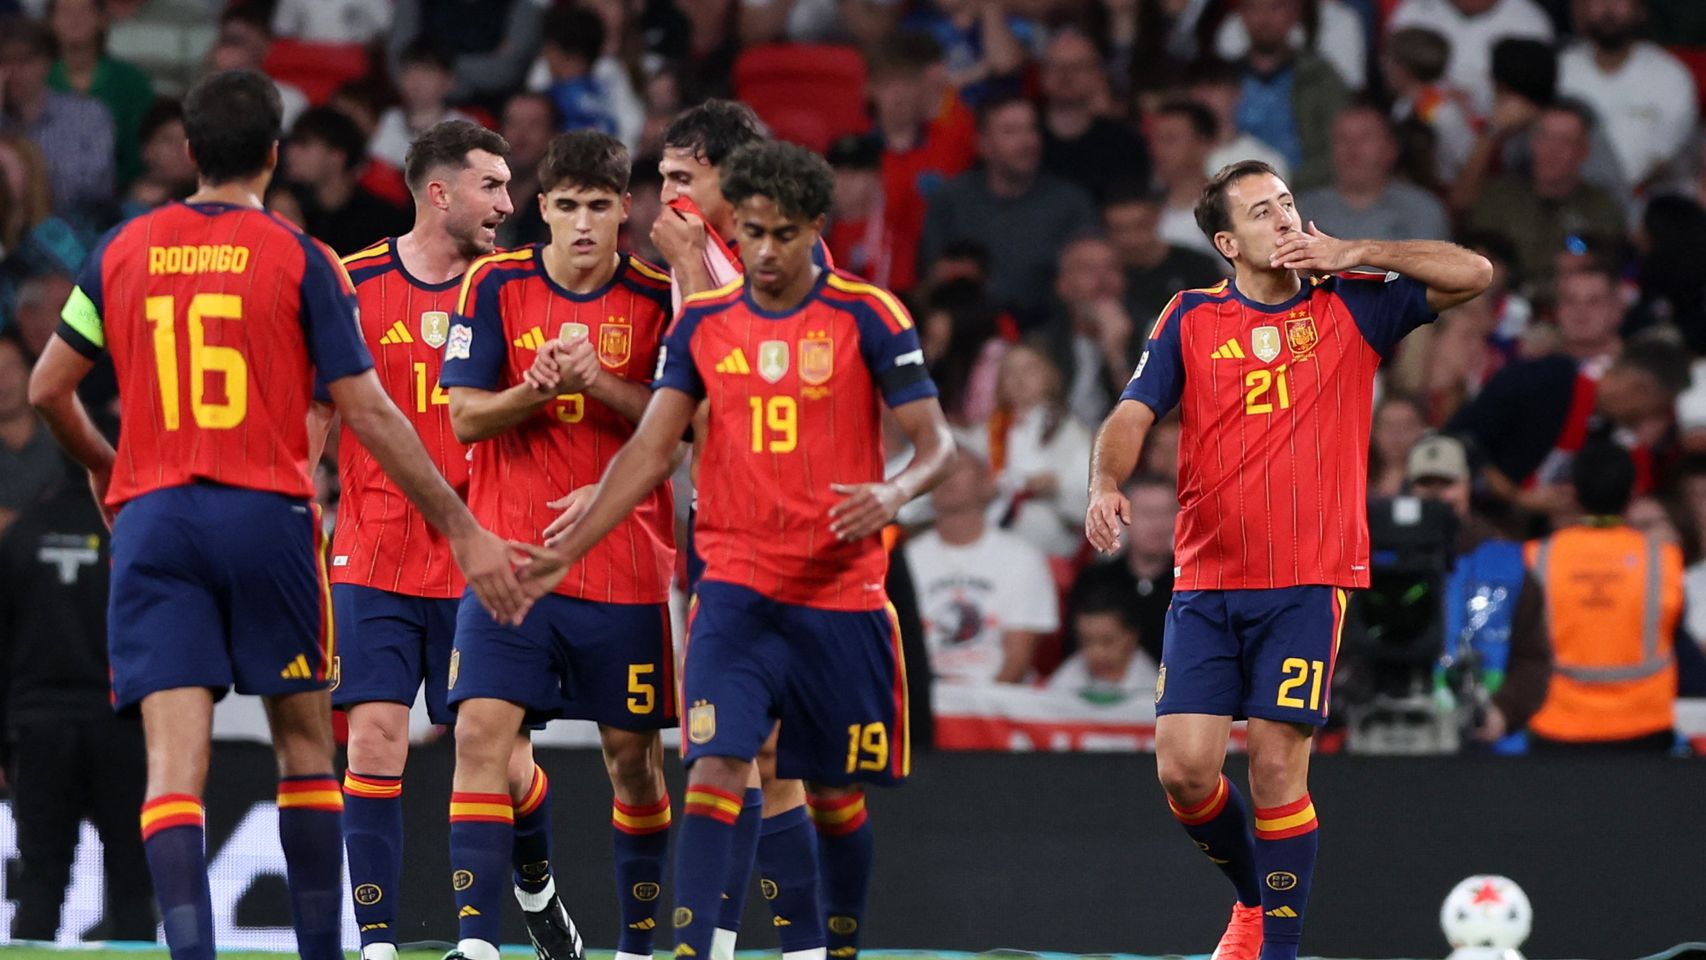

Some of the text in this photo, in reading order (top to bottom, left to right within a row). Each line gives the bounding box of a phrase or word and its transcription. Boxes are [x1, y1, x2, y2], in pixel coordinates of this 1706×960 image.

[149, 245, 249, 273] RODRIGO
[144, 294, 248, 430] 16
[414, 362, 450, 412] 14
[1245, 364, 1290, 415] 21
[749, 396, 798, 453] 19
[627, 663, 654, 714] 5
[1276, 657, 1324, 709] 21
[847, 721, 889, 773] 19
